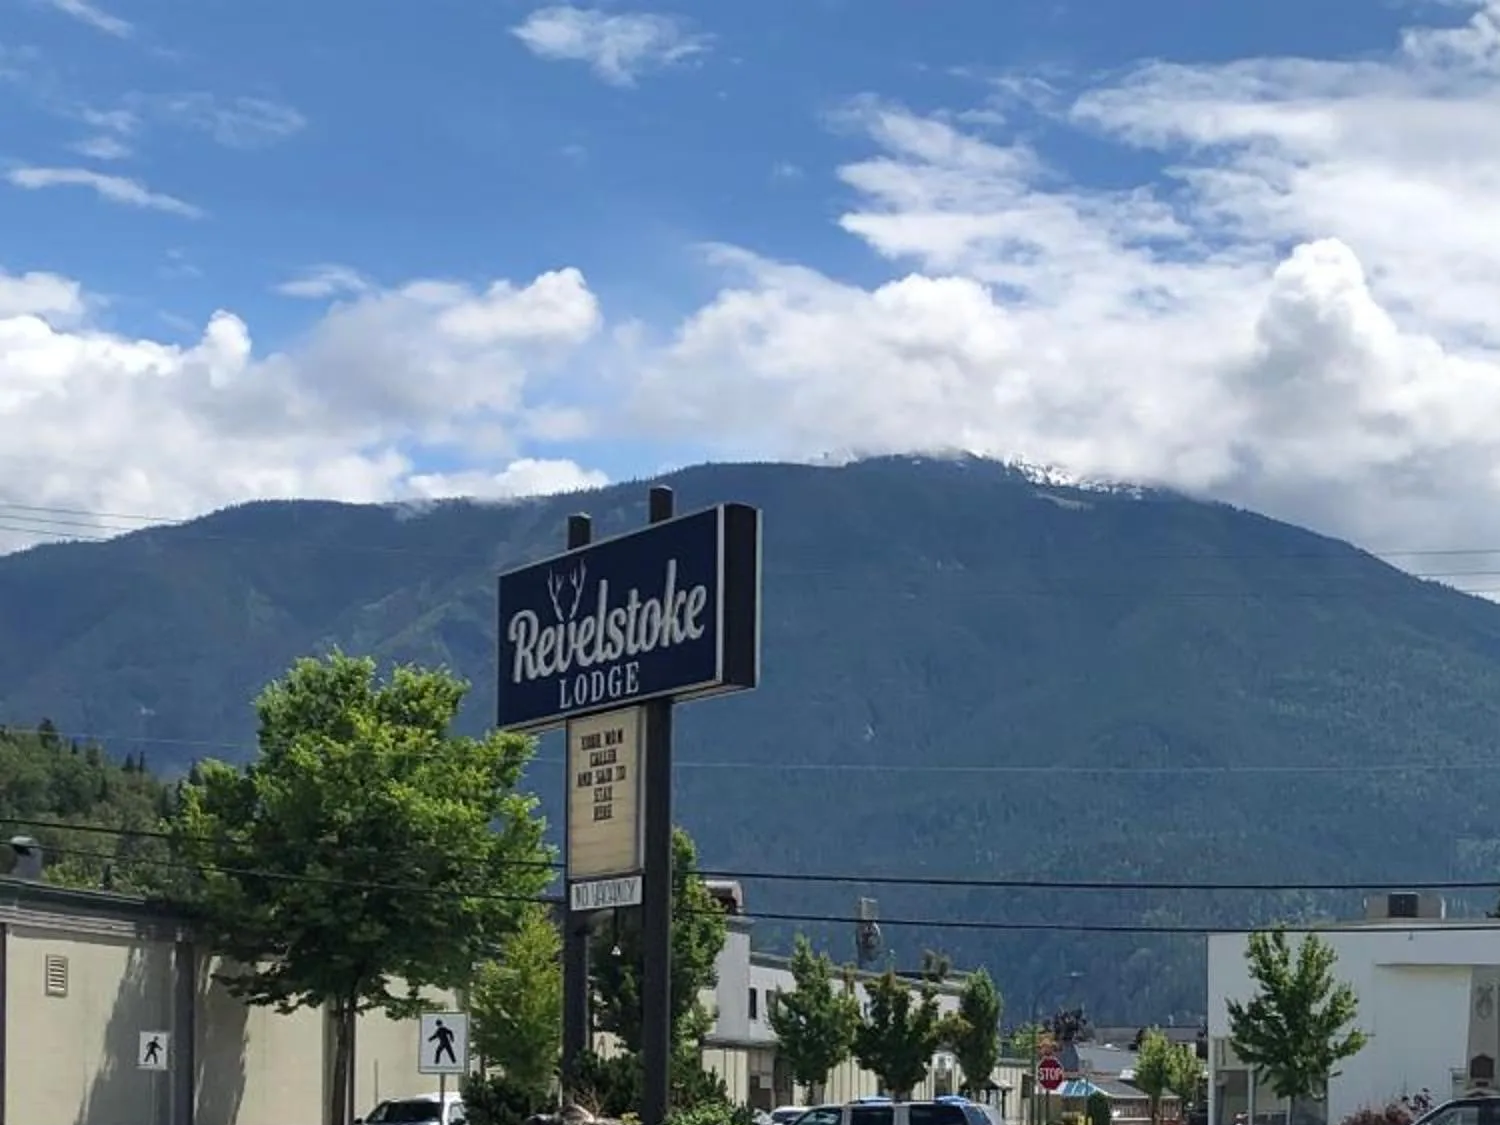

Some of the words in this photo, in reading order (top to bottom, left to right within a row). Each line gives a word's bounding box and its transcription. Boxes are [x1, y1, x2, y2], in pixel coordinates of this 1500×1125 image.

[507, 558, 706, 684] Revelstoke
[559, 660, 640, 709] LODGE
[1039, 1067, 1062, 1081] STOP
